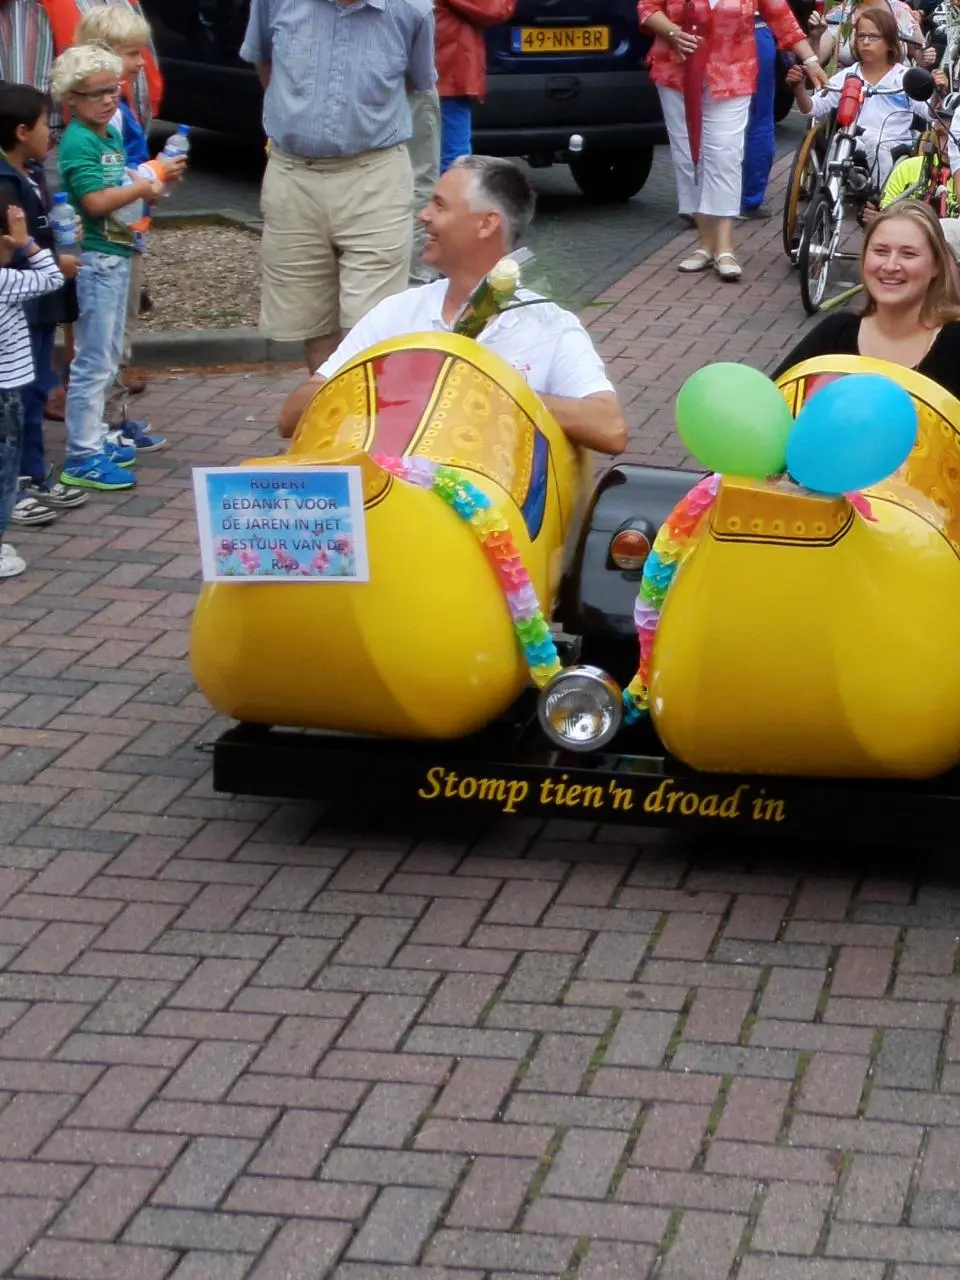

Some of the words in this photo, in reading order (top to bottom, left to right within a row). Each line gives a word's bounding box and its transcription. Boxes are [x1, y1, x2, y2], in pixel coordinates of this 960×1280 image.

[523, 30, 603, 48] 49-NN-BR
[250, 478, 305, 489] ROBERT
[222, 498, 290, 510] BEDANKT
[294, 498, 338, 510] VOOR
[222, 518, 241, 530] DE
[245, 518, 289, 530] JAREN
[294, 518, 309, 530] IN
[314, 518, 341, 530] HET
[221, 538, 288, 551] BESTUUR
[292, 539, 321, 551] VAN
[327, 539, 346, 551] DE
[418, 767, 529, 812] Stomp
[539, 774, 635, 810] tien'n
[643, 778, 749, 818] droad
[752, 788, 785, 821] in
